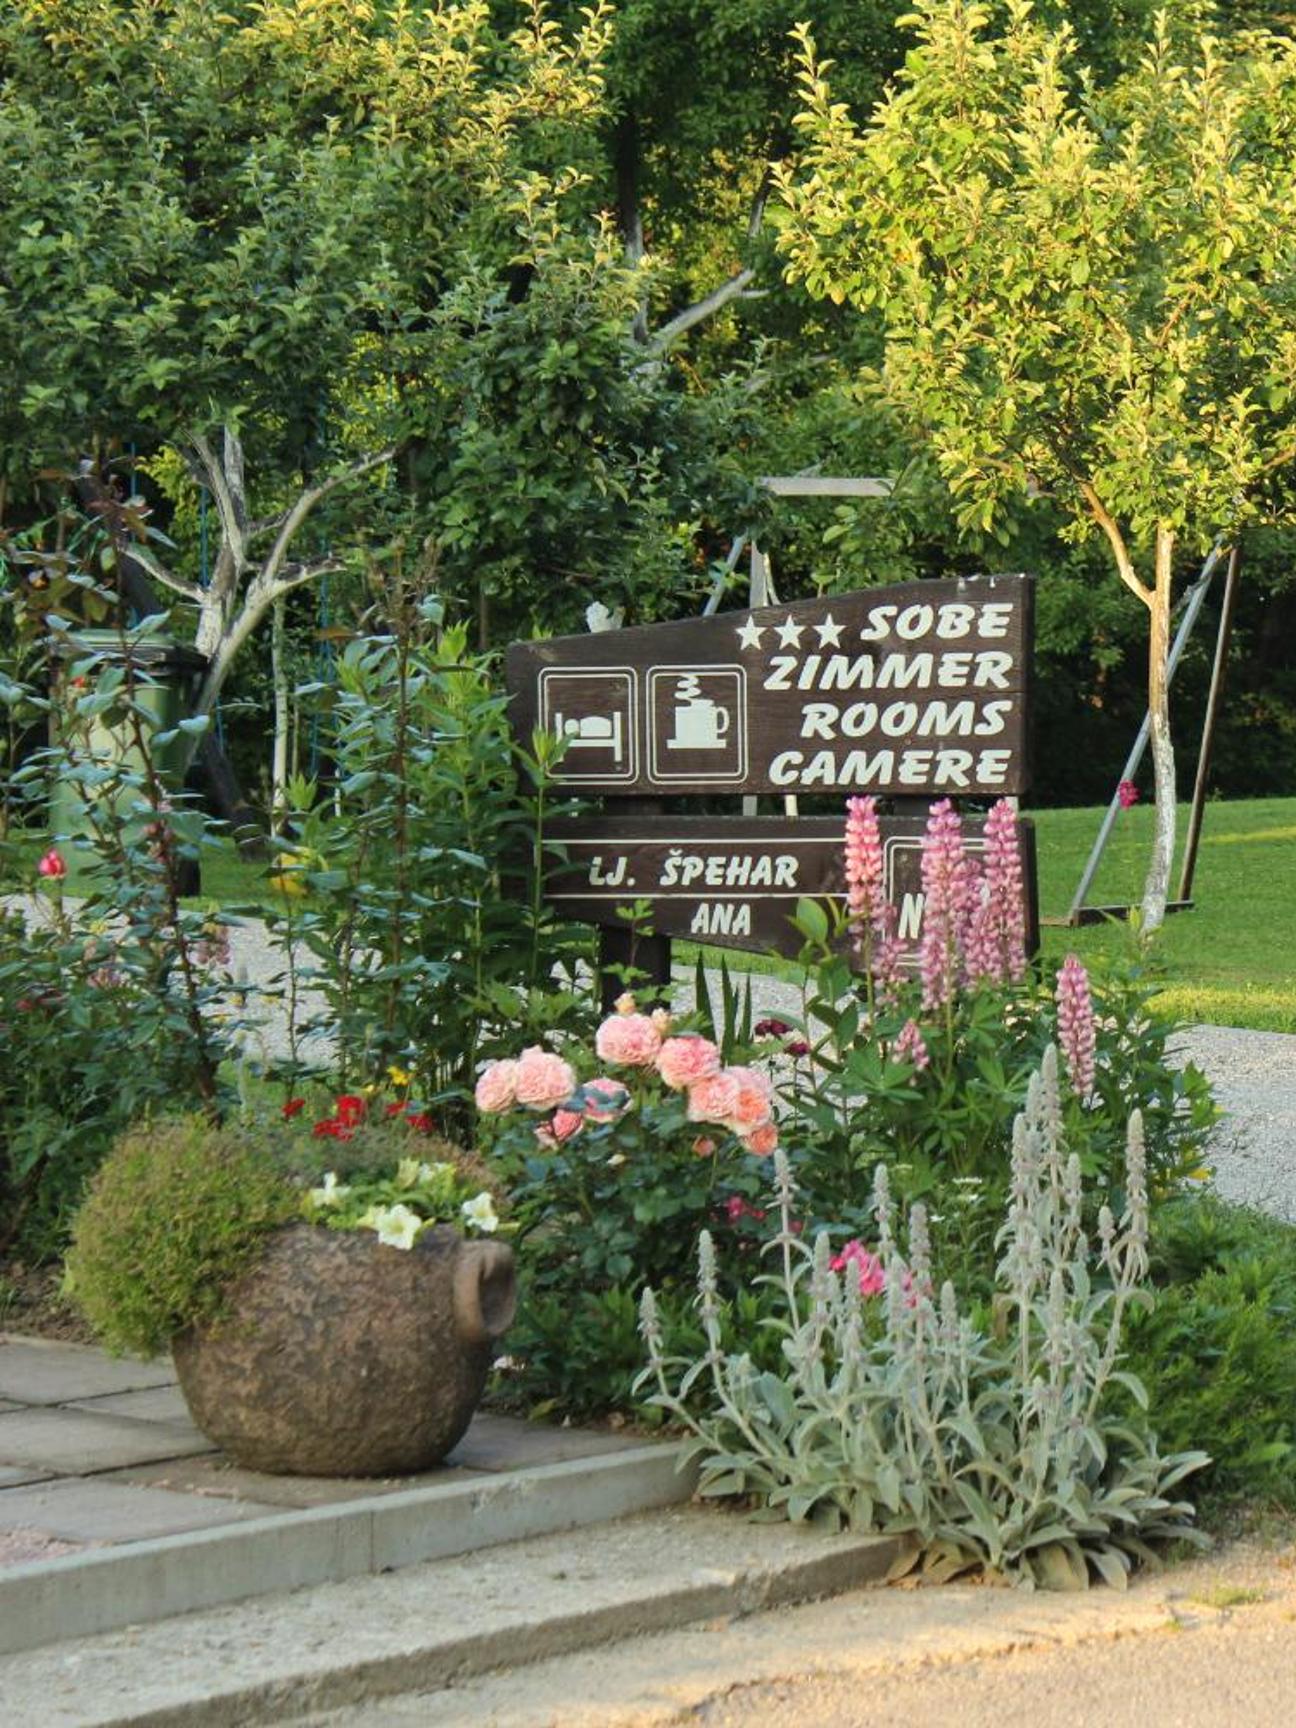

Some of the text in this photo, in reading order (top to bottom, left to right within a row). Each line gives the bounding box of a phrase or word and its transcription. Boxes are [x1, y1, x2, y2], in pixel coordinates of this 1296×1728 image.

[861, 604, 1013, 640] SOBE
[764, 652, 1012, 691] ZIMMER
[801, 701, 1012, 738] ROOMS
[769, 750, 1011, 785] CAMERE
[660, 849, 798, 887] ŠPEHAR
[691, 904, 751, 935] ANA
